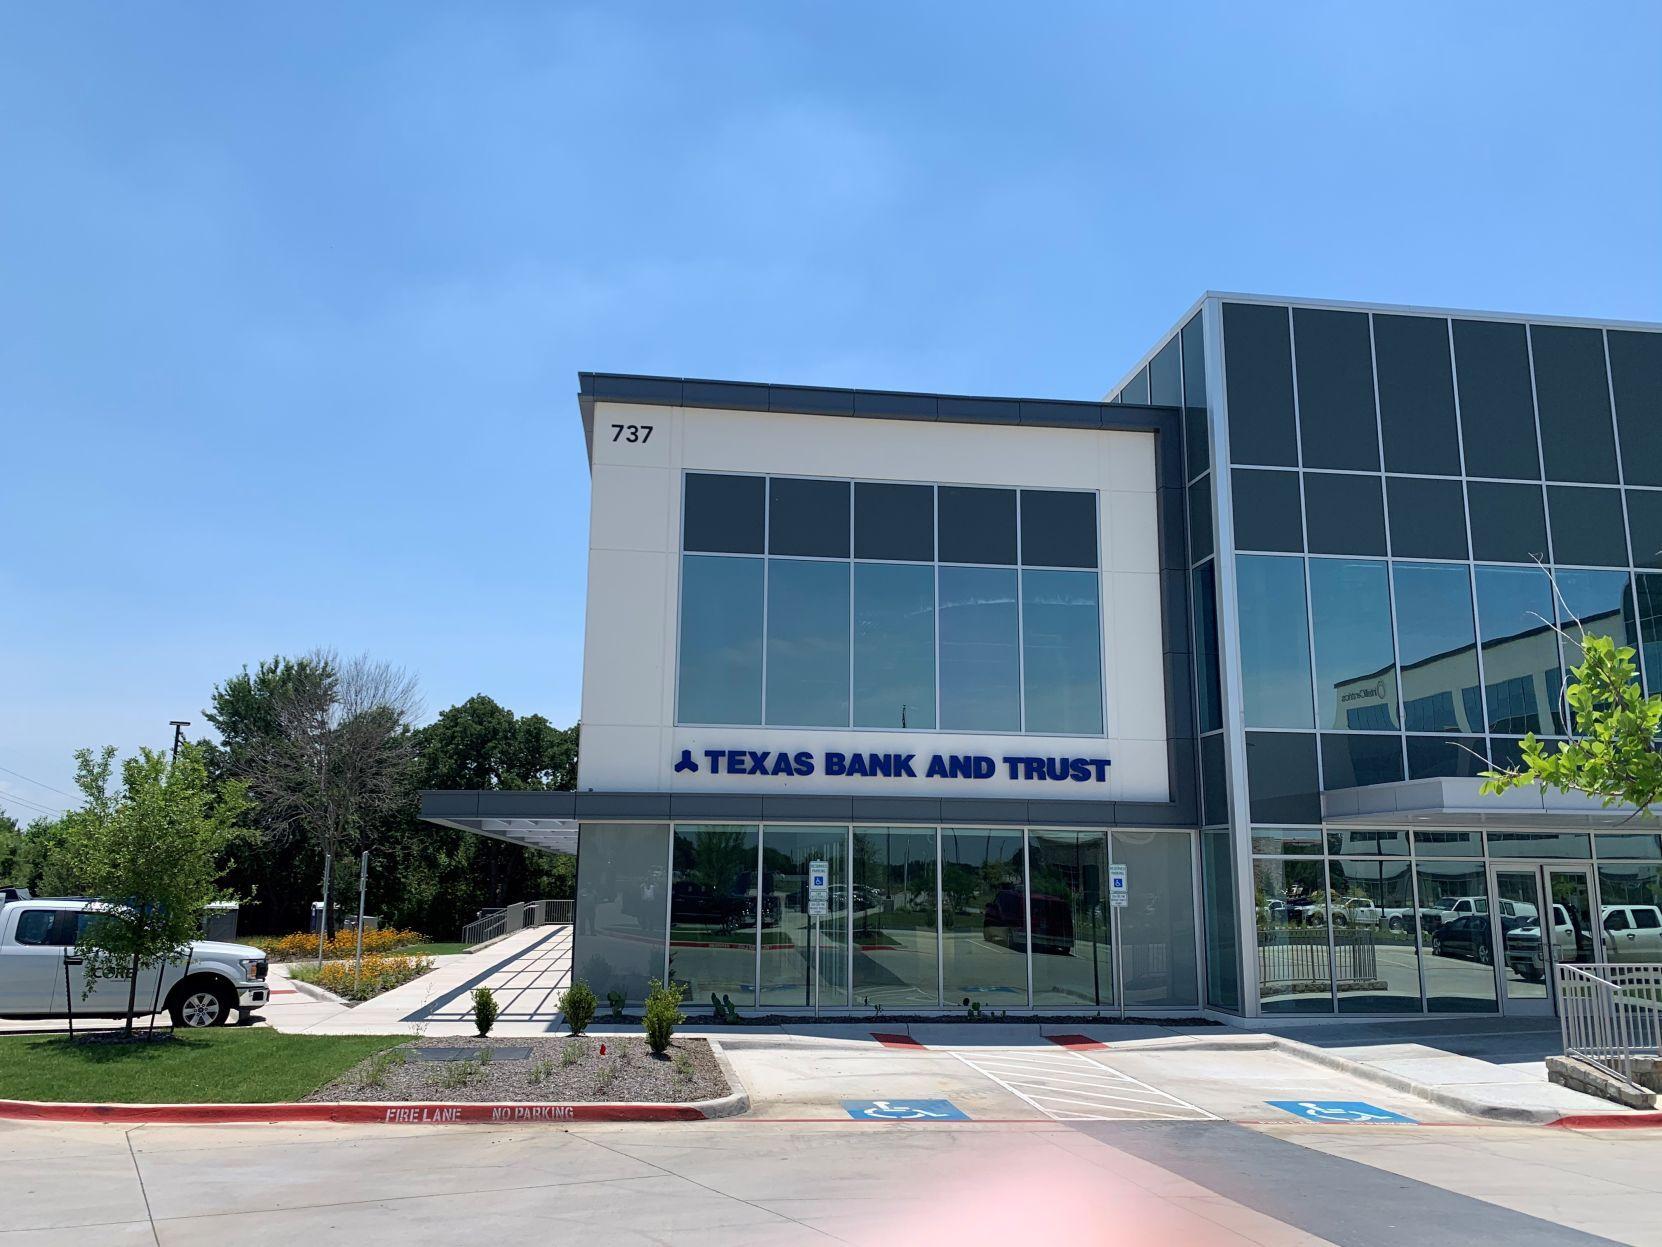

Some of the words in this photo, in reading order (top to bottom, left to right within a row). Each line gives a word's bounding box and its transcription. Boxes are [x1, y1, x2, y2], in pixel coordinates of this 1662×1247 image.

[611, 424, 654, 443] 737
[704, 750, 815, 776] TEXAS
[825, 752, 917, 778] BANK
[926, 755, 996, 779] AND
[1003, 756, 1111, 782] TRUST
[385, 1108, 420, 1122] FIRE
[422, 1108, 462, 1122] LANE
[492, 1107, 511, 1121] NO
[515, 1106, 575, 1121] PARKING
